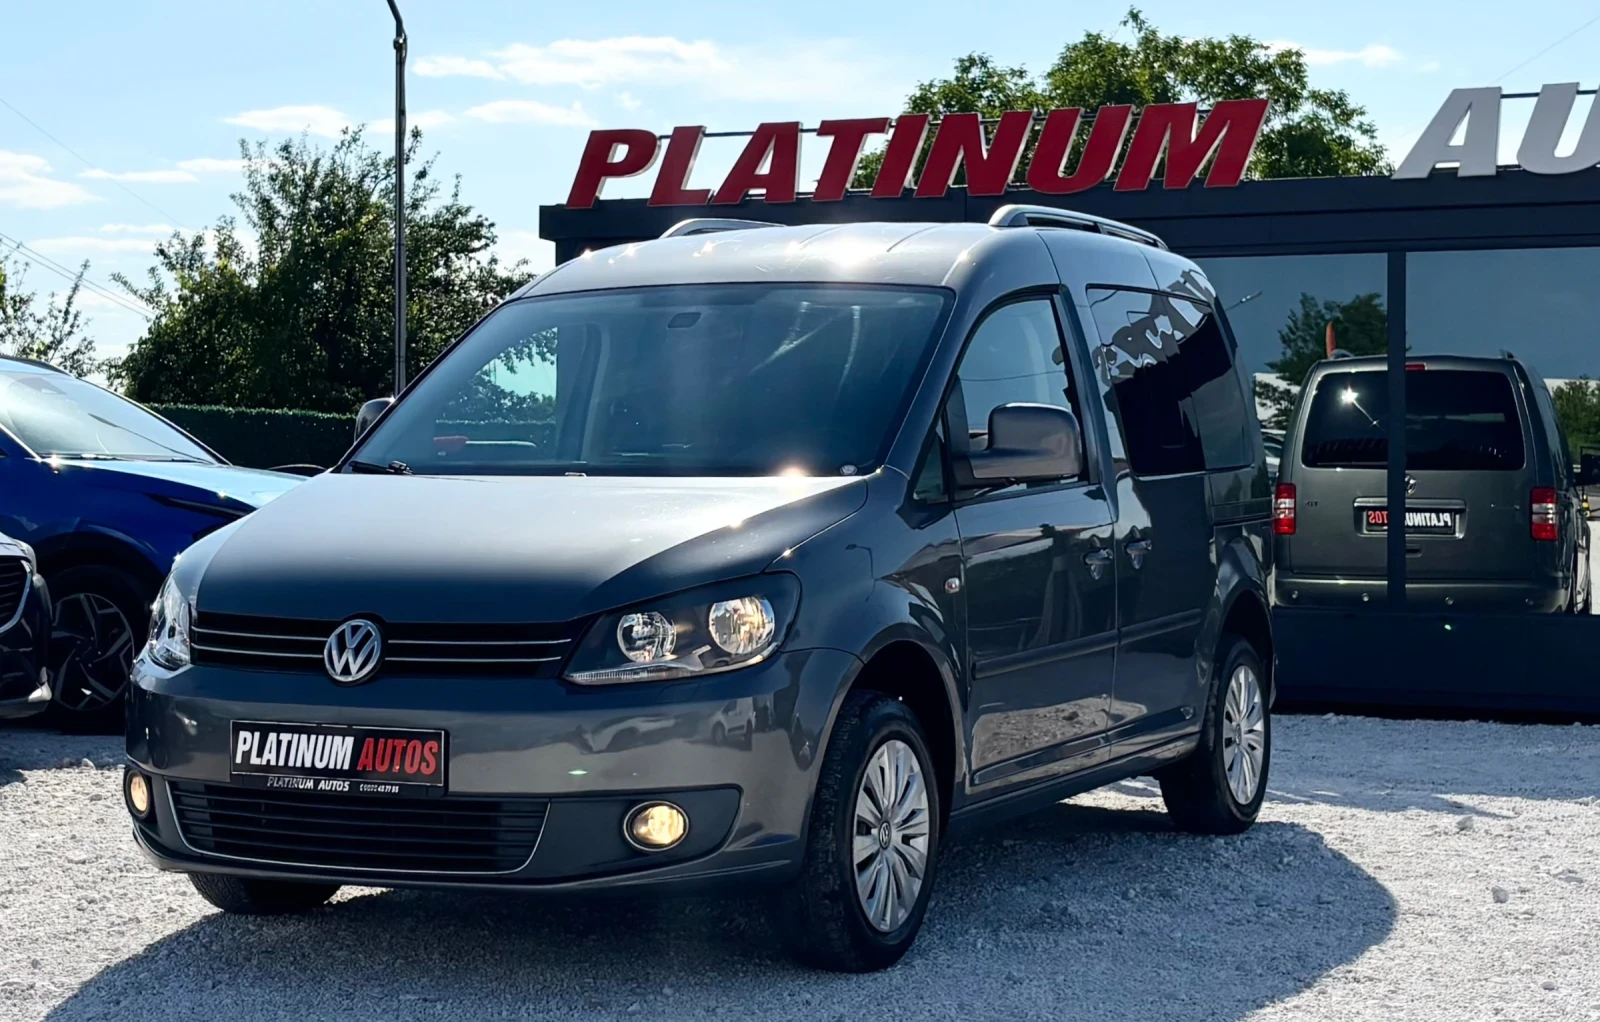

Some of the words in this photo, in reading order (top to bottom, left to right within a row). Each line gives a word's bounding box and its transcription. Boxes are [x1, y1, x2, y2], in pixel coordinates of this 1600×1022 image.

[566, 99, 1270, 209] PLATINUM
[235, 730, 354, 770] PLATINUM
[356, 737, 438, 775] AUTOS
[267, 776, 314, 790] PLATINUM
[317, 779, 350, 792] AUTOS
